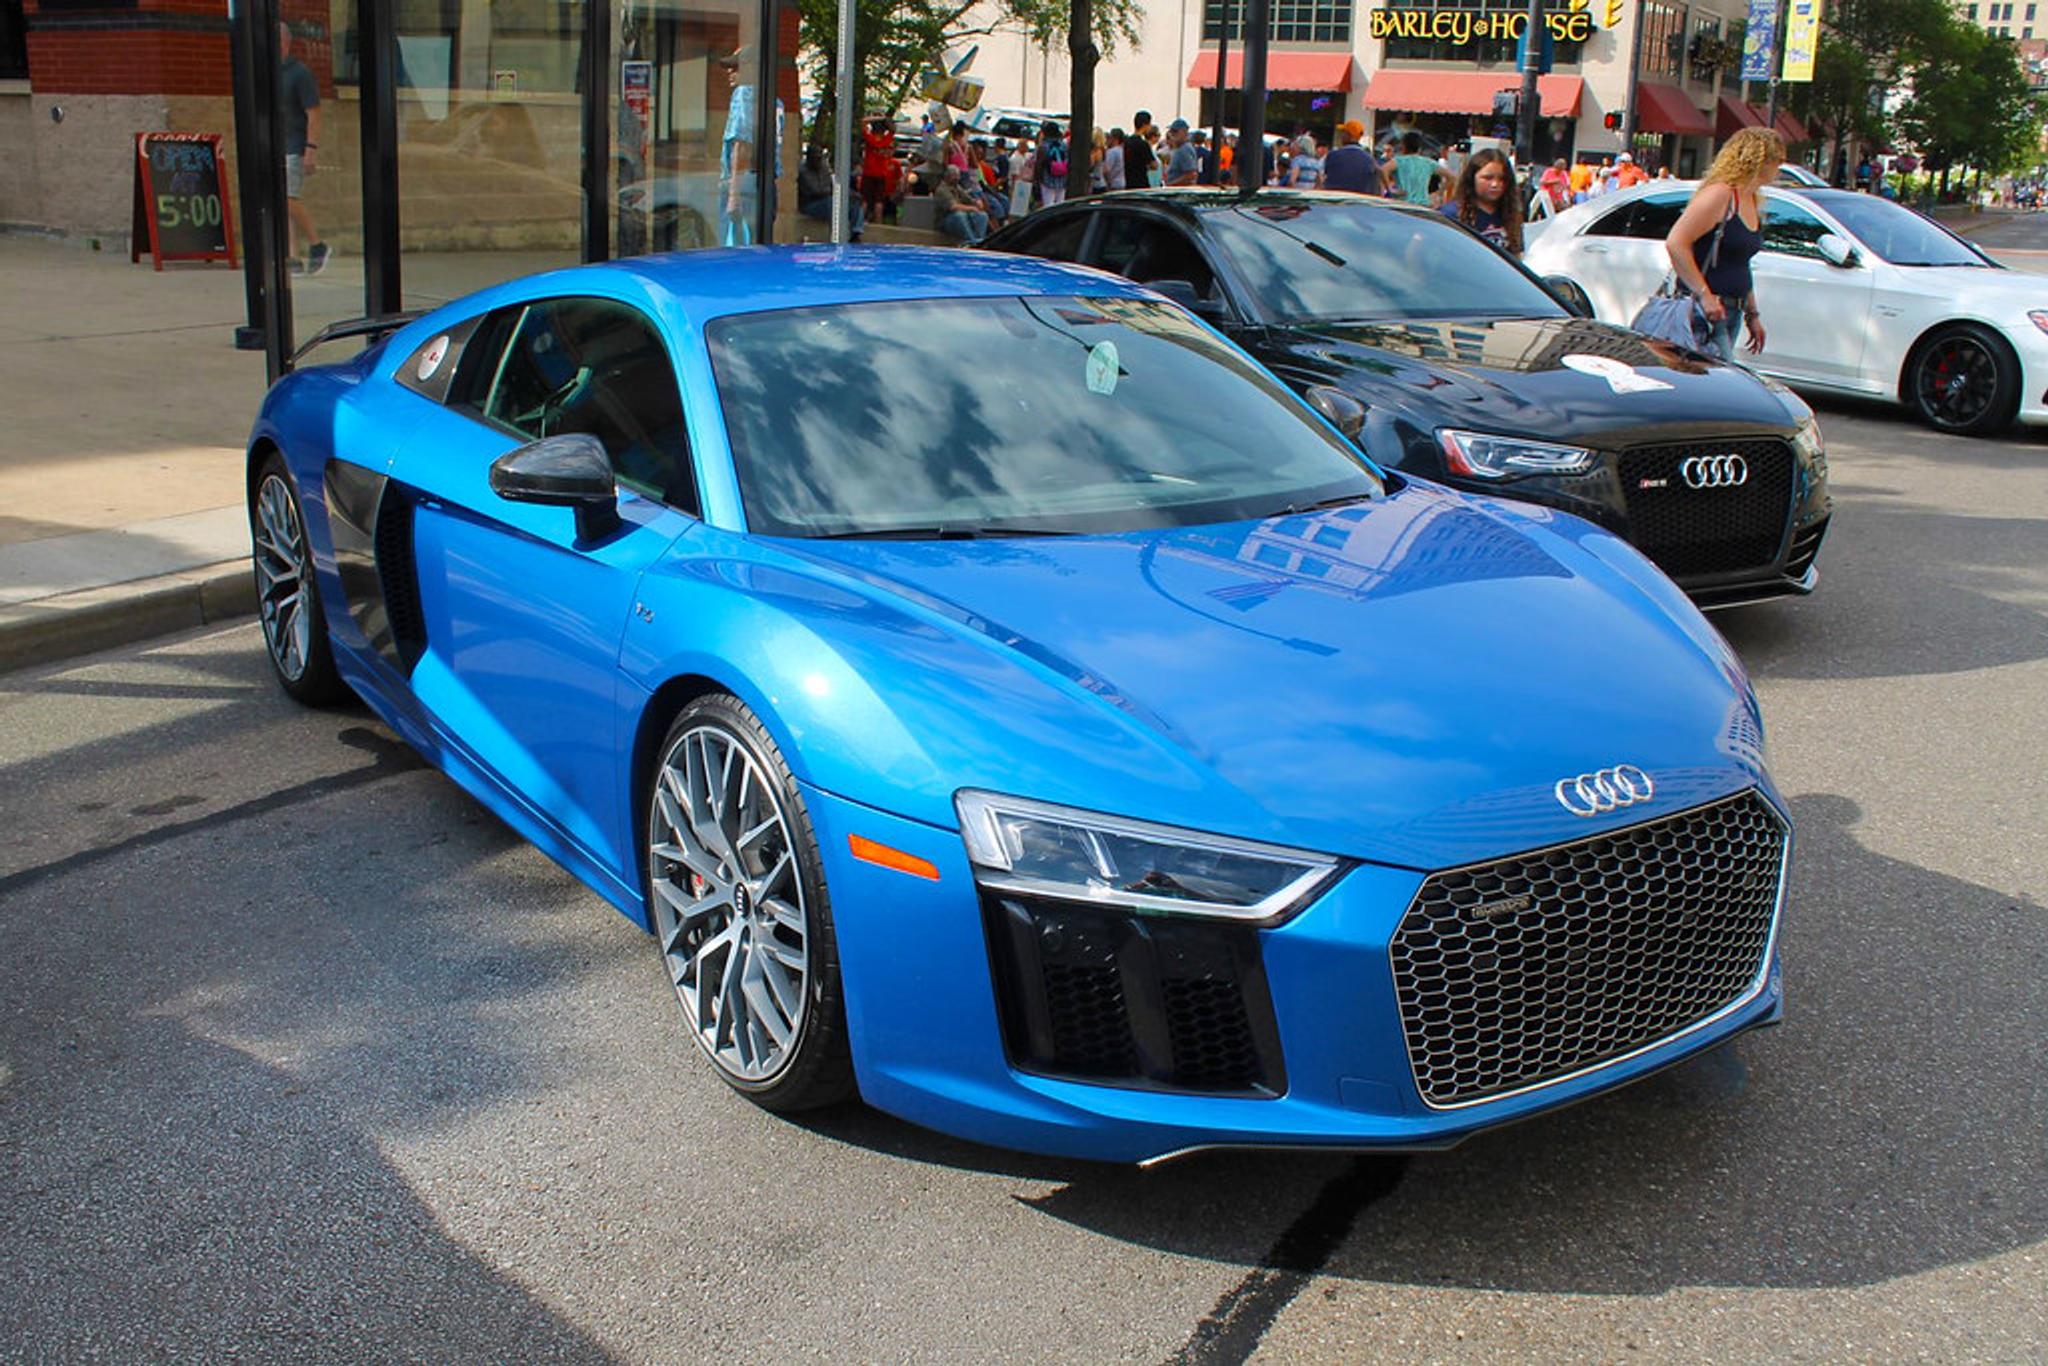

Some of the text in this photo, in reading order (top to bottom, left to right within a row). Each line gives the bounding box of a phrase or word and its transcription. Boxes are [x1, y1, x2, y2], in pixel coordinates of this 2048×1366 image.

[1371, 11, 1590, 45] BARLEY HOSE
[157, 194, 221, 228] 5:00
